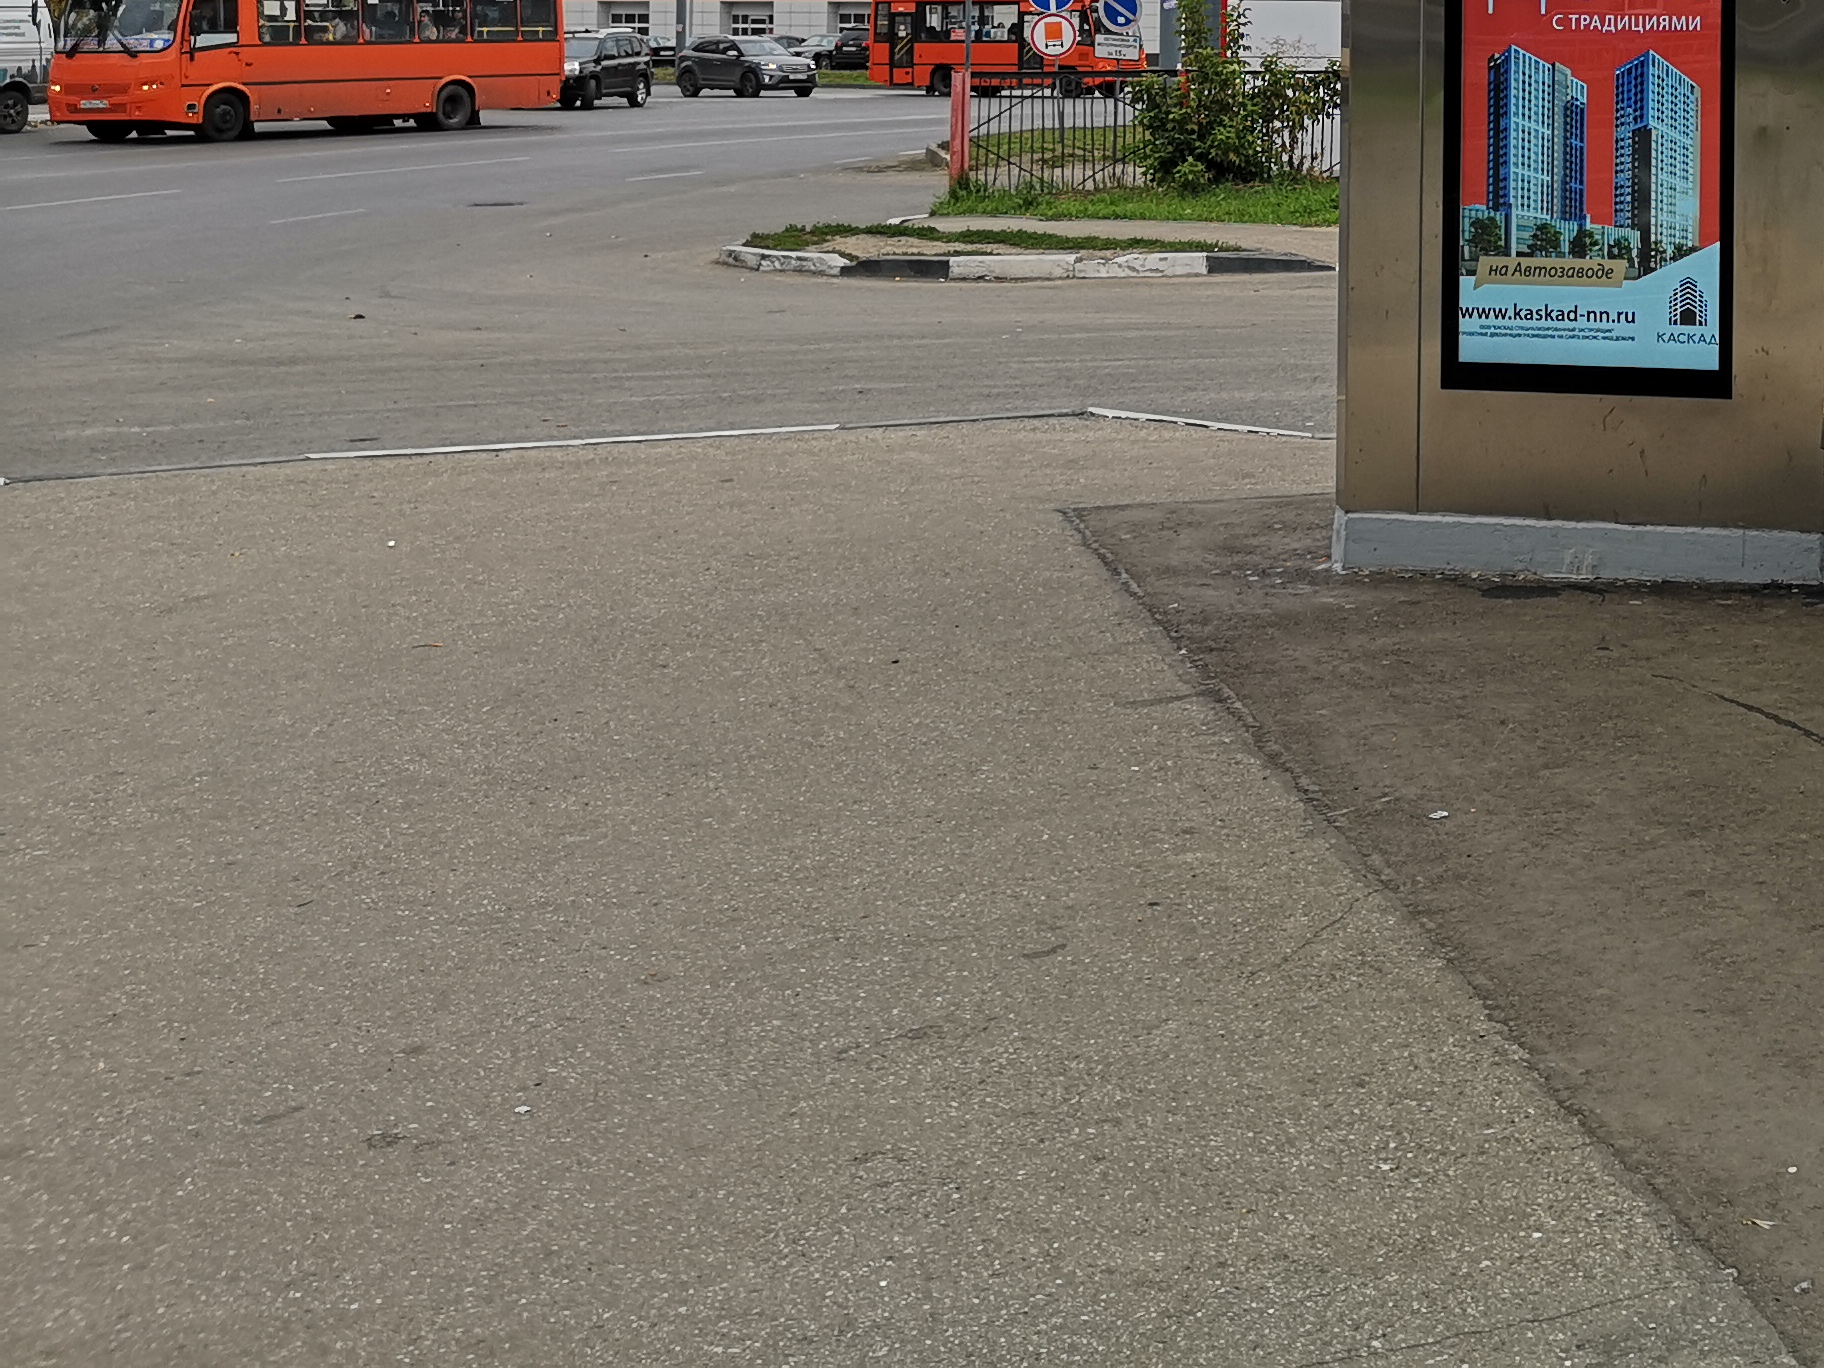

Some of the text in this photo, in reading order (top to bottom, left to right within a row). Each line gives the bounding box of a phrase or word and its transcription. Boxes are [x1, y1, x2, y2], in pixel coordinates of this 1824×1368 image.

[1552, 14, 1701, 34] С ТРАДИЦИЯМИ
[1488, 262, 1615, 280] на Автозаводе
[1459, 303, 1636, 324] www.kaskad-nn.ru
[1656, 331, 1719, 346] КАСКАД
